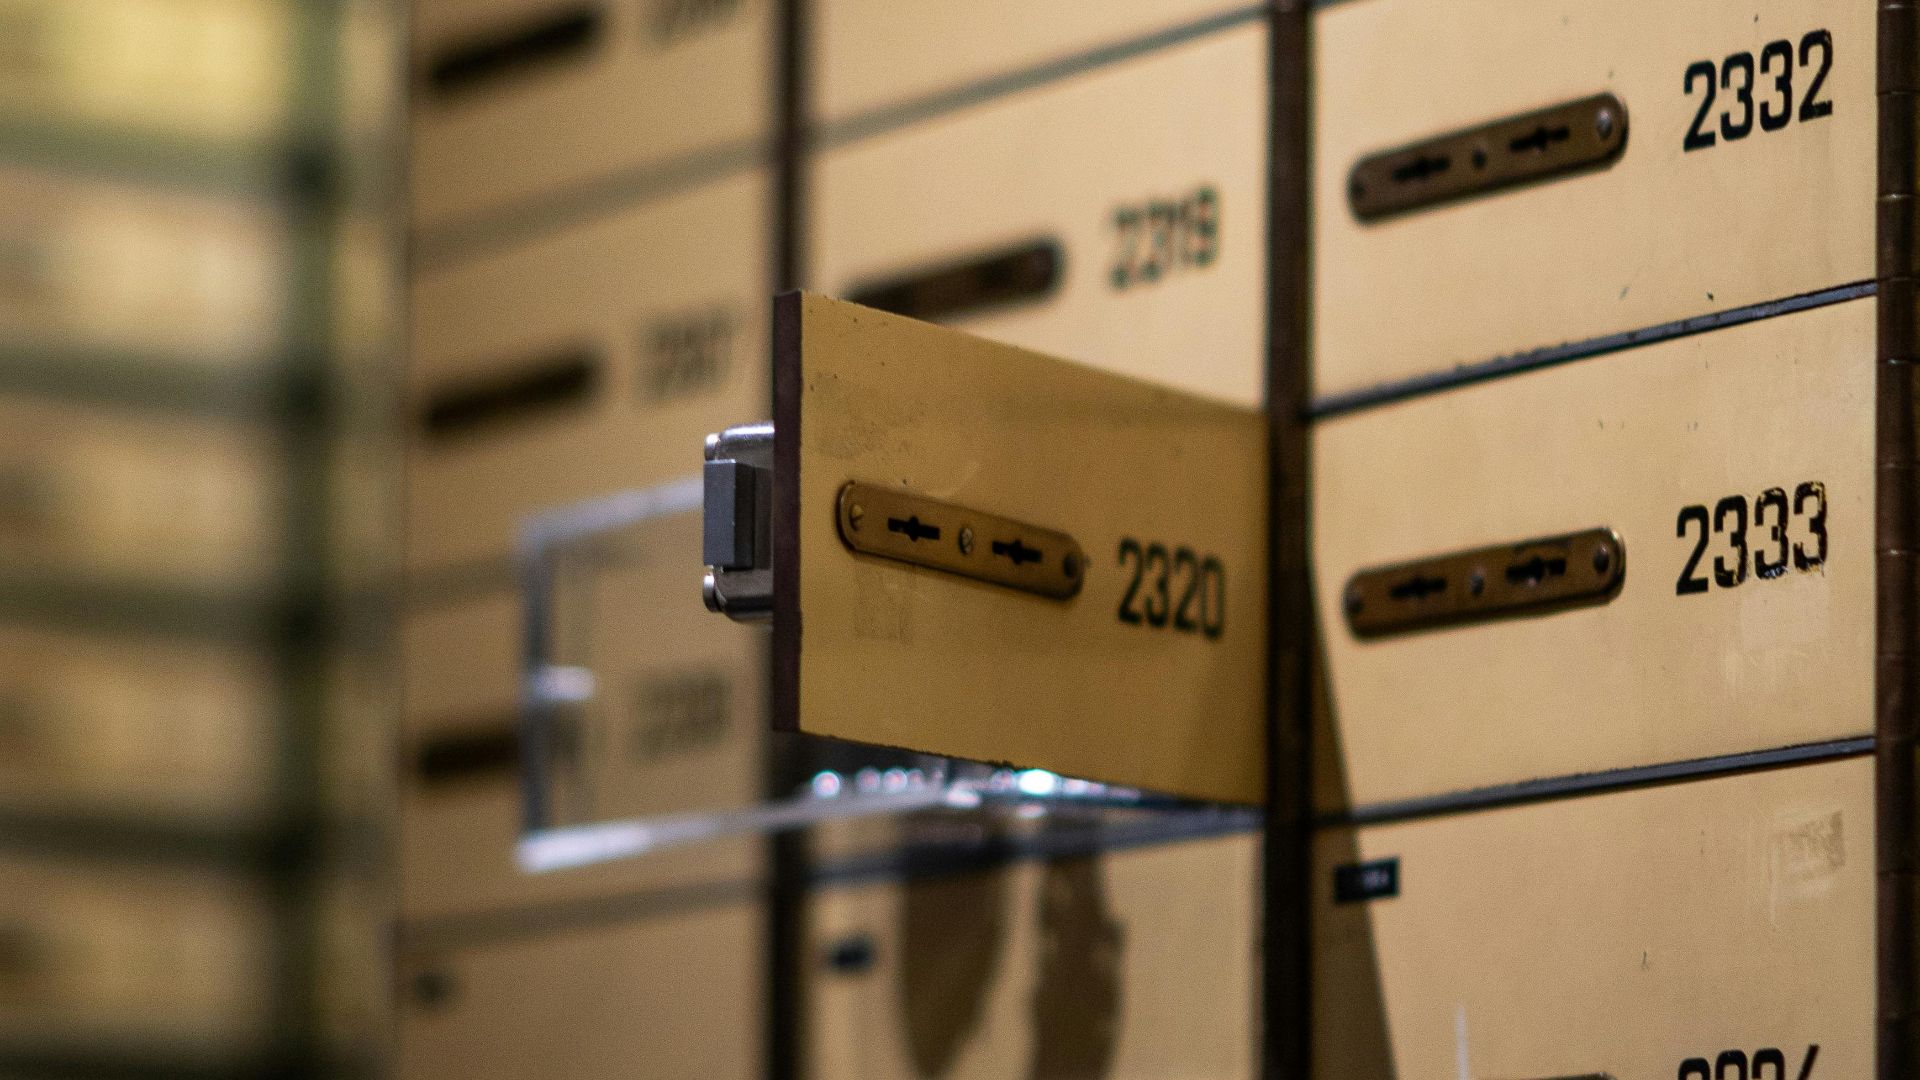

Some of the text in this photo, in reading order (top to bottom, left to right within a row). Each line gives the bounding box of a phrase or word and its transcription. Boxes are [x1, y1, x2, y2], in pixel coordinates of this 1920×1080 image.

[1683, 28, 1833, 152] 2332
[1109, 184, 1220, 290] 2319
[1117, 537, 1225, 640] 2320
[1676, 480, 1828, 596] 2333
